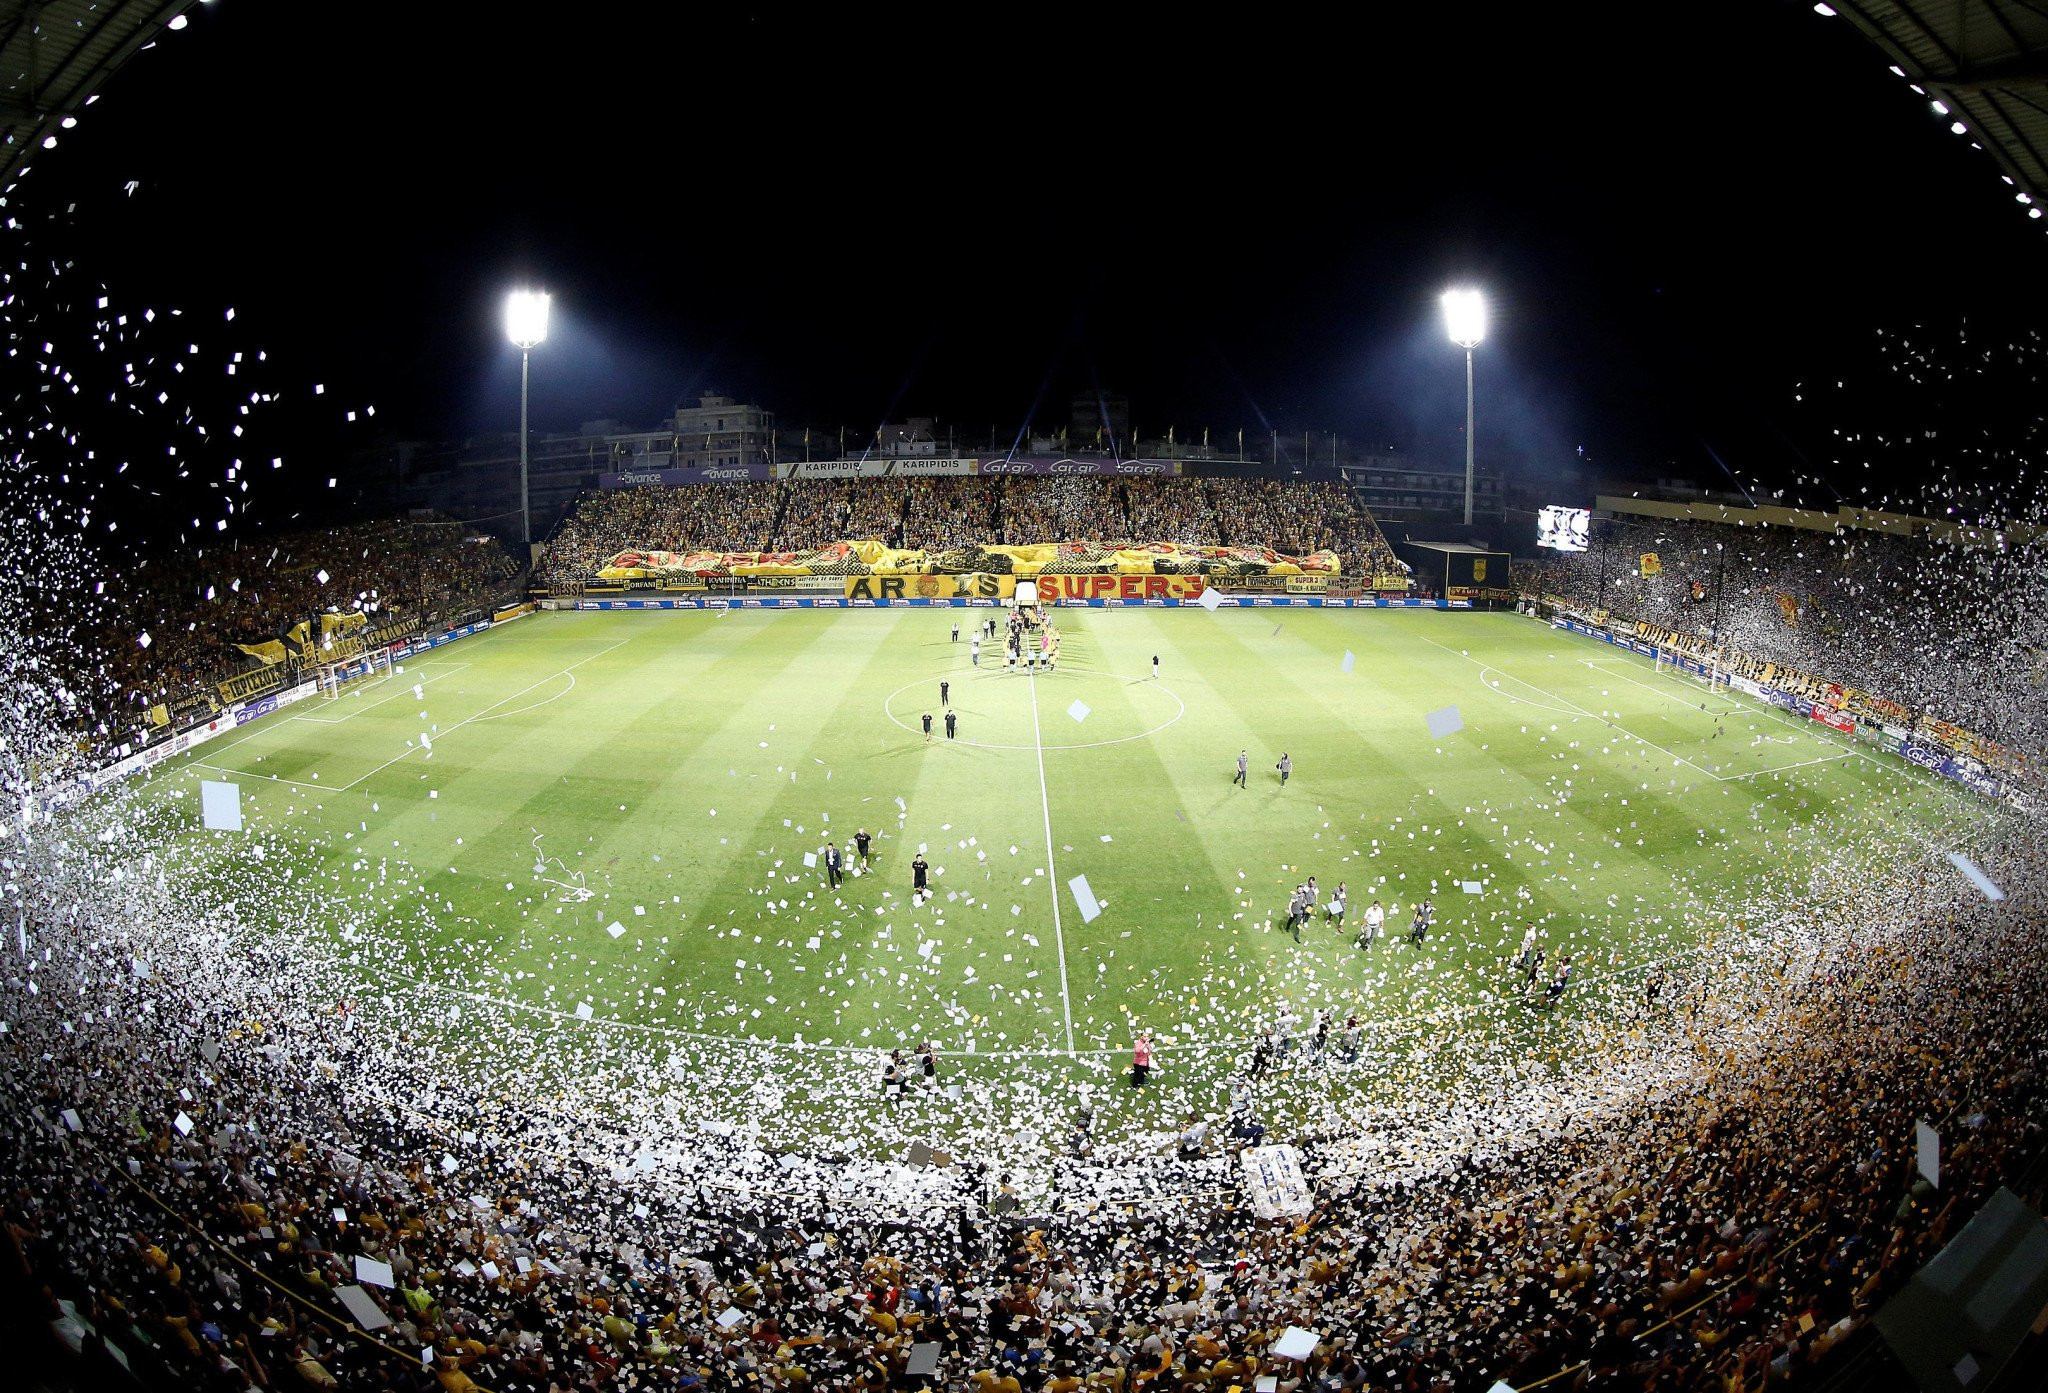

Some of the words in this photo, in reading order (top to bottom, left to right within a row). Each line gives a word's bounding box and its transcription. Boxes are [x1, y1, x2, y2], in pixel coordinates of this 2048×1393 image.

[805, 462, 860, 471] KARIPIDIS
[903, 460, 959, 468] KARIPIDIS
[624, 473, 661, 484] avance
[709, 468, 749, 479] avance
[277, 688, 300, 701] TOSHIBA
[1855, 724, 1869, 737] PIZZA
[1906, 747, 1943, 769] car.gr
